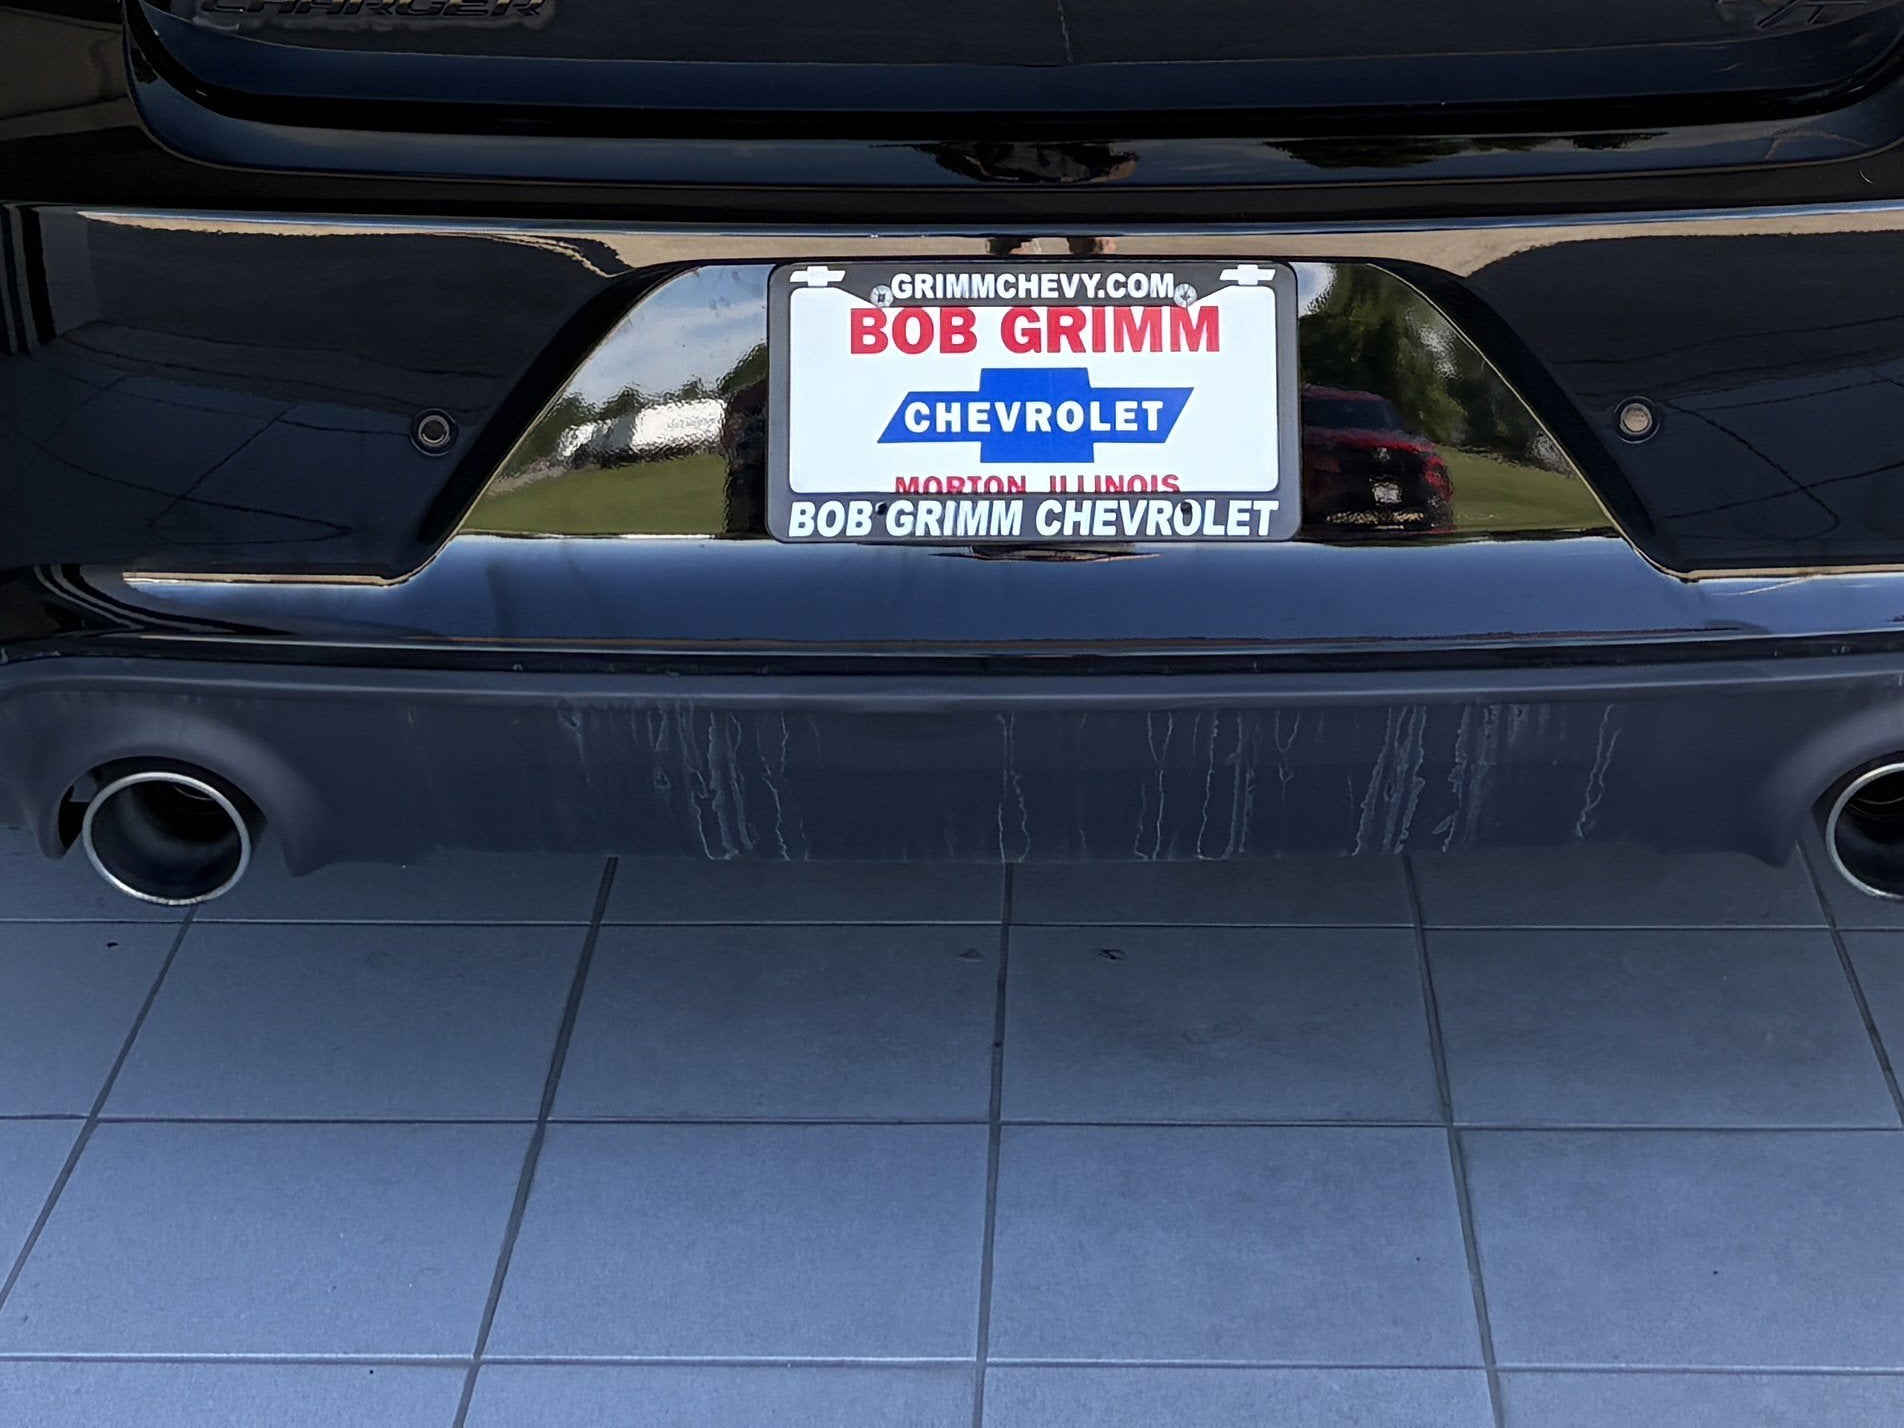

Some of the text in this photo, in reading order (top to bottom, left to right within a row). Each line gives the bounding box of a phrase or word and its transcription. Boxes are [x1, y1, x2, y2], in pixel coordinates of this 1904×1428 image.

[891, 271, 1175, 301] GRIMMCHEVY.COM
[851, 305, 1220, 355] BOB GRIMM
[904, 399, 1165, 434] CHEVROLET
[788, 499, 1280, 538] BOB GRIMM CHEVROLET
